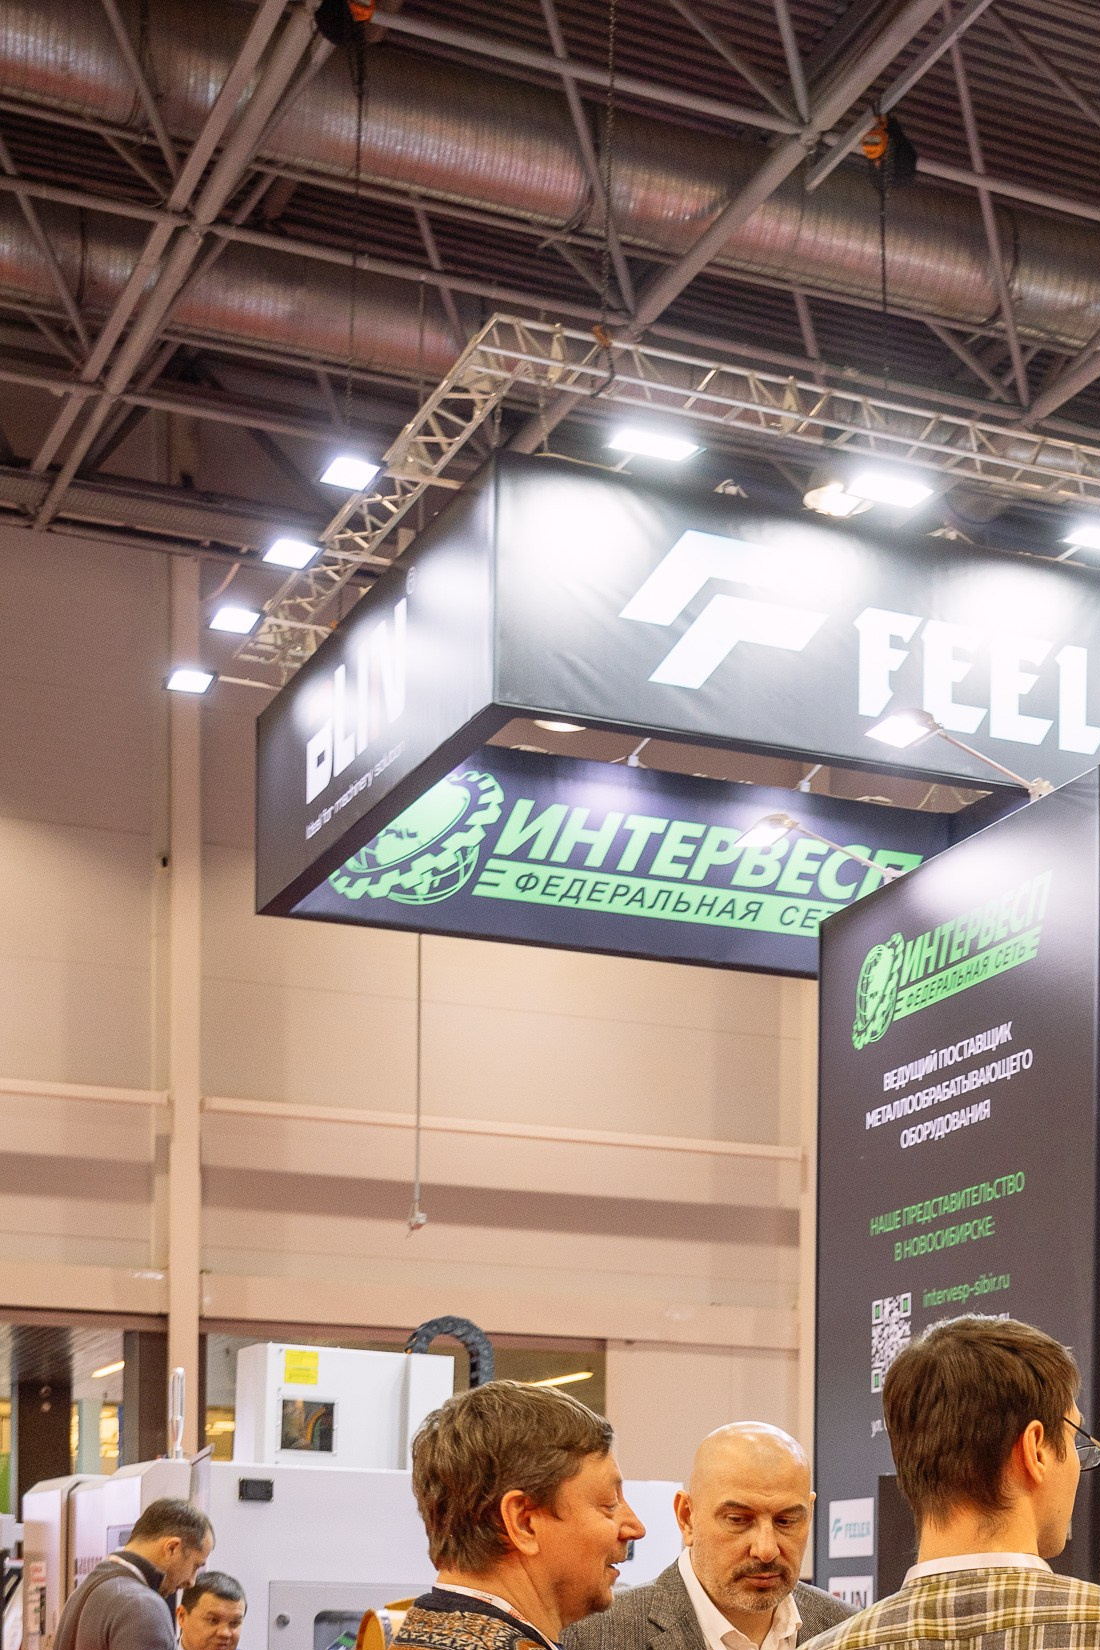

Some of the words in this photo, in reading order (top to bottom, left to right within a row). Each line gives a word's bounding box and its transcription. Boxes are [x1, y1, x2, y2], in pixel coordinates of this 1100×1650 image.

[493, 798, 924, 901] ИНТЕРВЕСП
[516, 871, 763, 925] ФЕДЕРАЛЬНАЯ
[780, 905, 834, 929] СЕ
[899, 869, 1053, 988] ИНТЕРВЕСП
[905, 954, 990, 1009] ФЕДЕРАЛЬНАЯ
[993, 939, 1027, 970] СЕТЬ
[865, 1049, 1033, 1130] МЕТАЛЛООБРАБАТЫВАЮЩЕГО
[883, 1049, 939, 1092] ВЕДУЩИЙ
[939, 1021, 1013, 1070] ПОСТАВЩИК
[900, 1099, 991, 1149] ОБОРУДОВАНИЯ
[870, 1213, 901, 1236] НАШЕ
[902, 1171, 1025, 1227] ПРЕДСТАВИТЕЛЬСТВО
[894, 1242, 902, 1261] В
